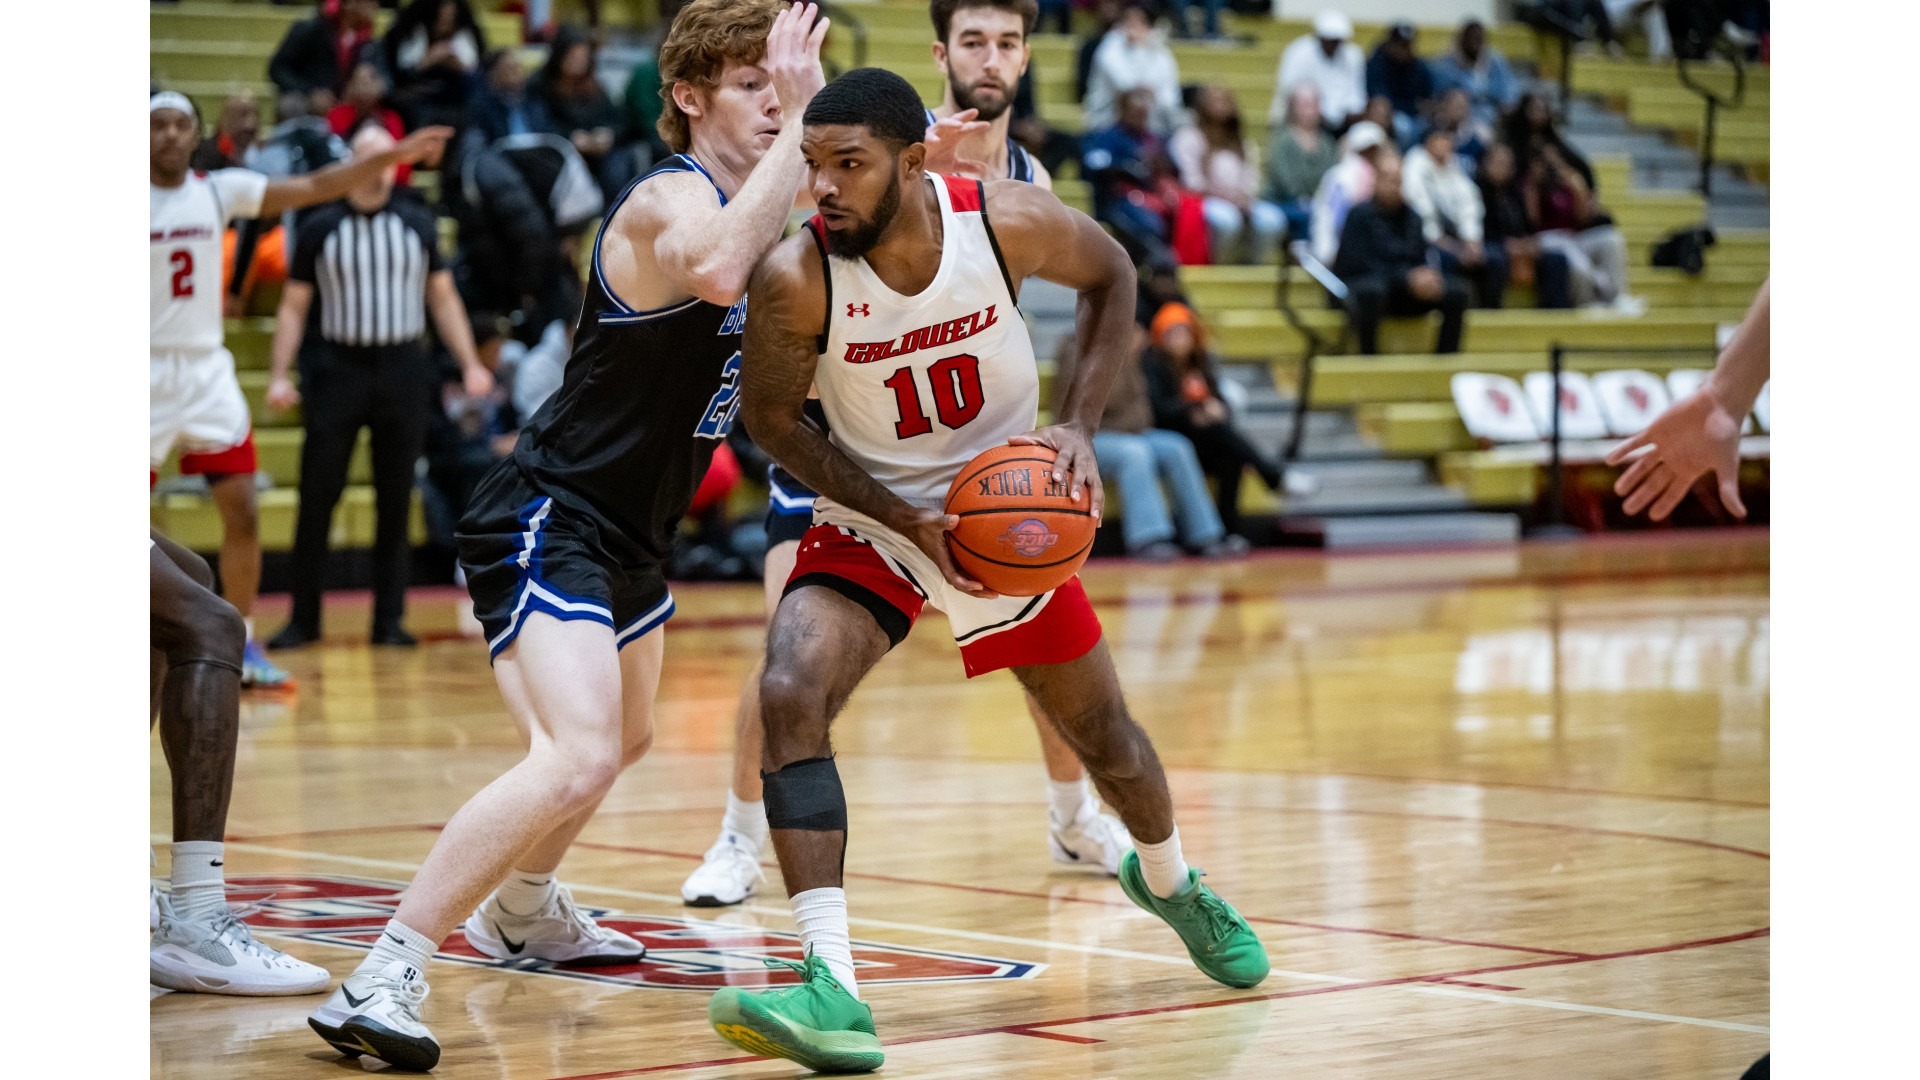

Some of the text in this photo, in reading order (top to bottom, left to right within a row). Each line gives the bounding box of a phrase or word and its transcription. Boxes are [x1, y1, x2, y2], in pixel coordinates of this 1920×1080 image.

[170, 249, 194, 298] 2
[693, 350, 742, 440] 2
[883, 353, 986, 440] 10
[978, 468, 1033, 497] ROCK
